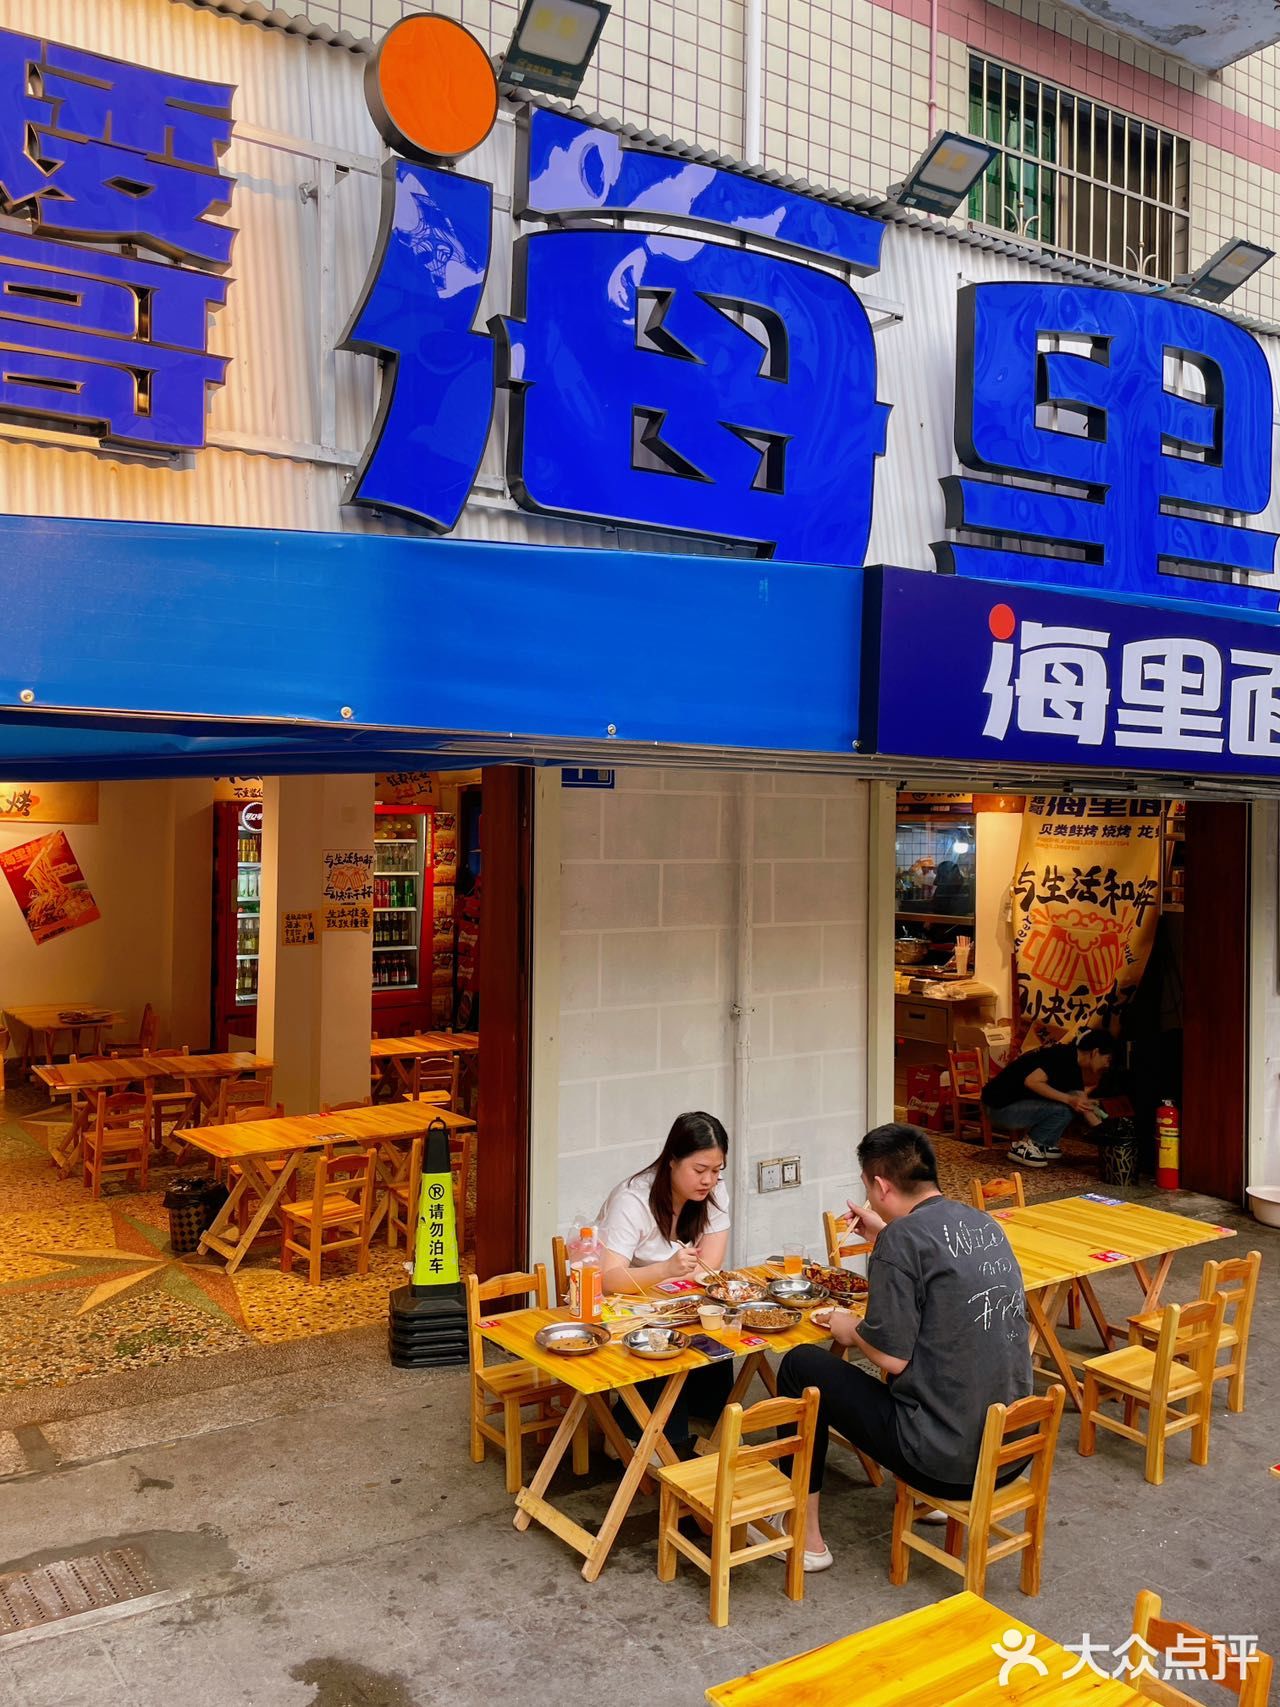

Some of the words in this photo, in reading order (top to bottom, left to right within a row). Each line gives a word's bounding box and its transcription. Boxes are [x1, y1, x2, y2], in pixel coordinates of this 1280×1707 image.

[0, 789, 33, 816] 烤
[1039, 823, 1099, 838] 贝类鲜烤
[1102, 824, 1132, 838] 烧烤
[1014, 862, 1158, 927] 与生活和解
[429, 1203, 444, 1274] 请勿泊车
